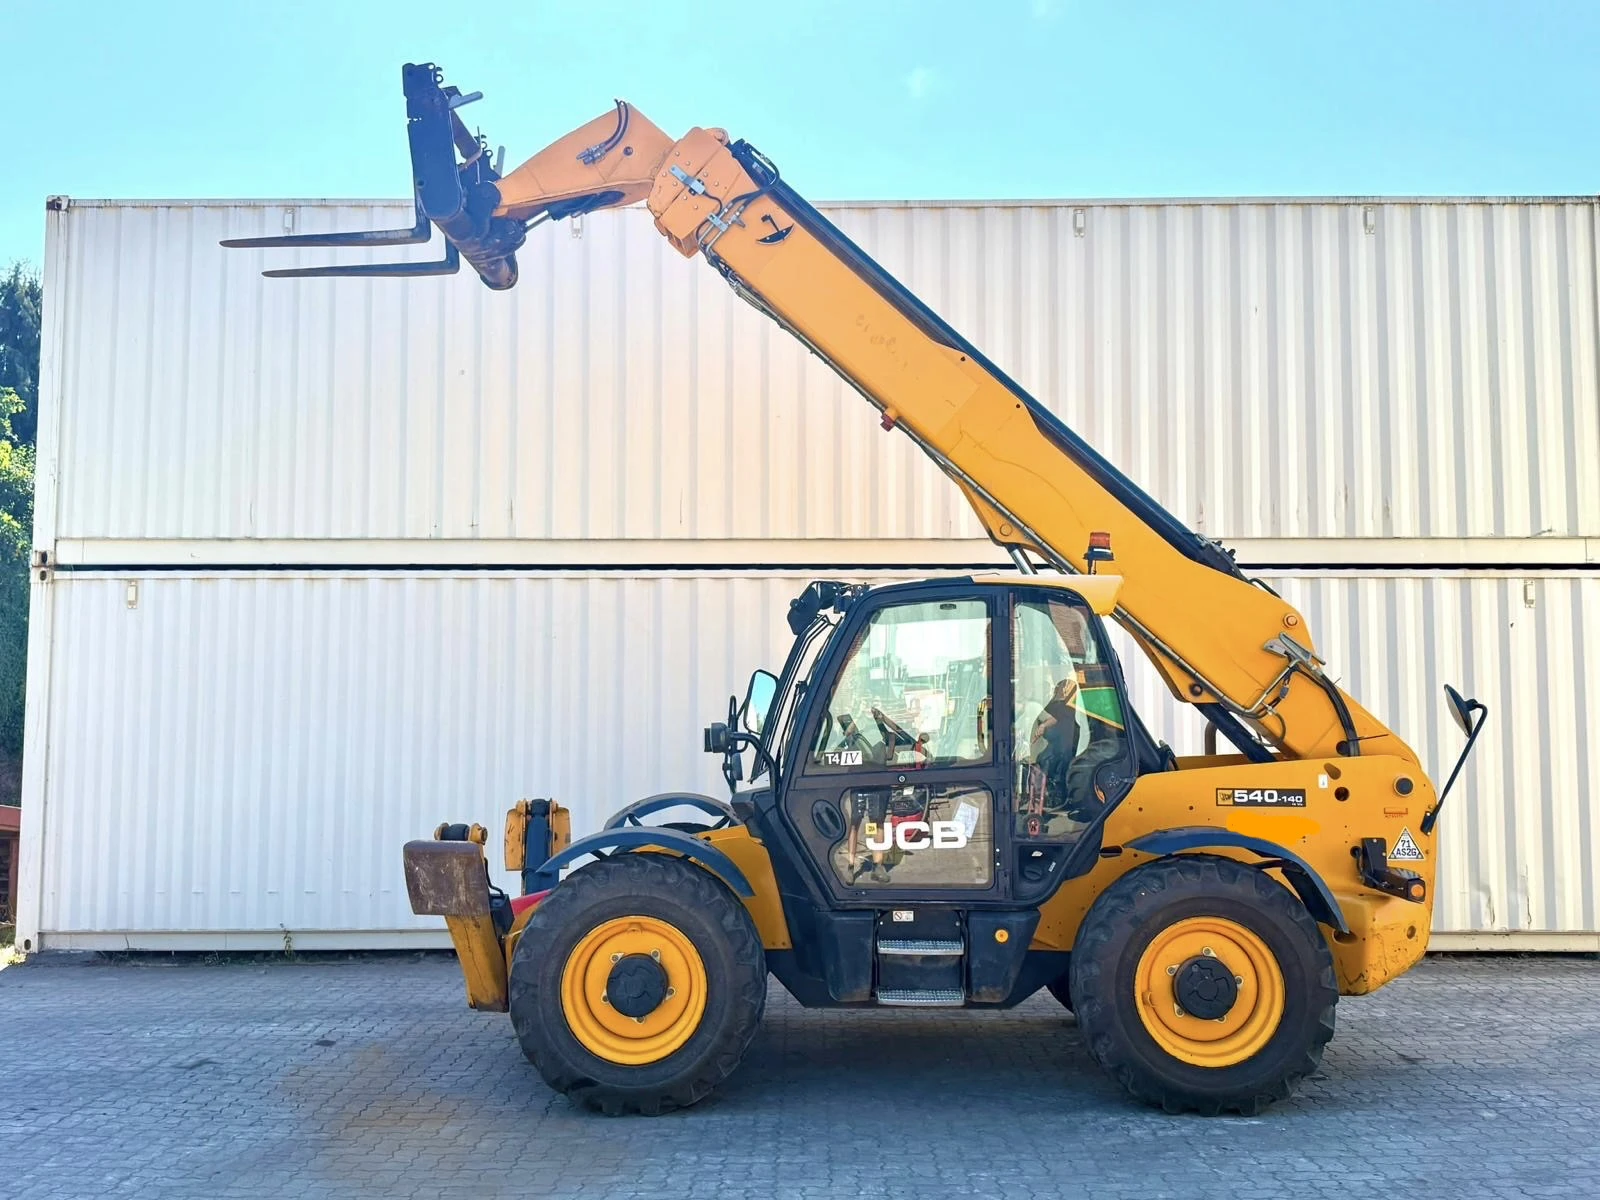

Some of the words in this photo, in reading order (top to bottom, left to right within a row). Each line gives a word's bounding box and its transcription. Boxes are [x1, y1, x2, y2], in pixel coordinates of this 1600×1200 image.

[1234, 790, 1303, 803] 540-140
[866, 821, 967, 850] JCB
[1401, 840, 1411, 848] 71
